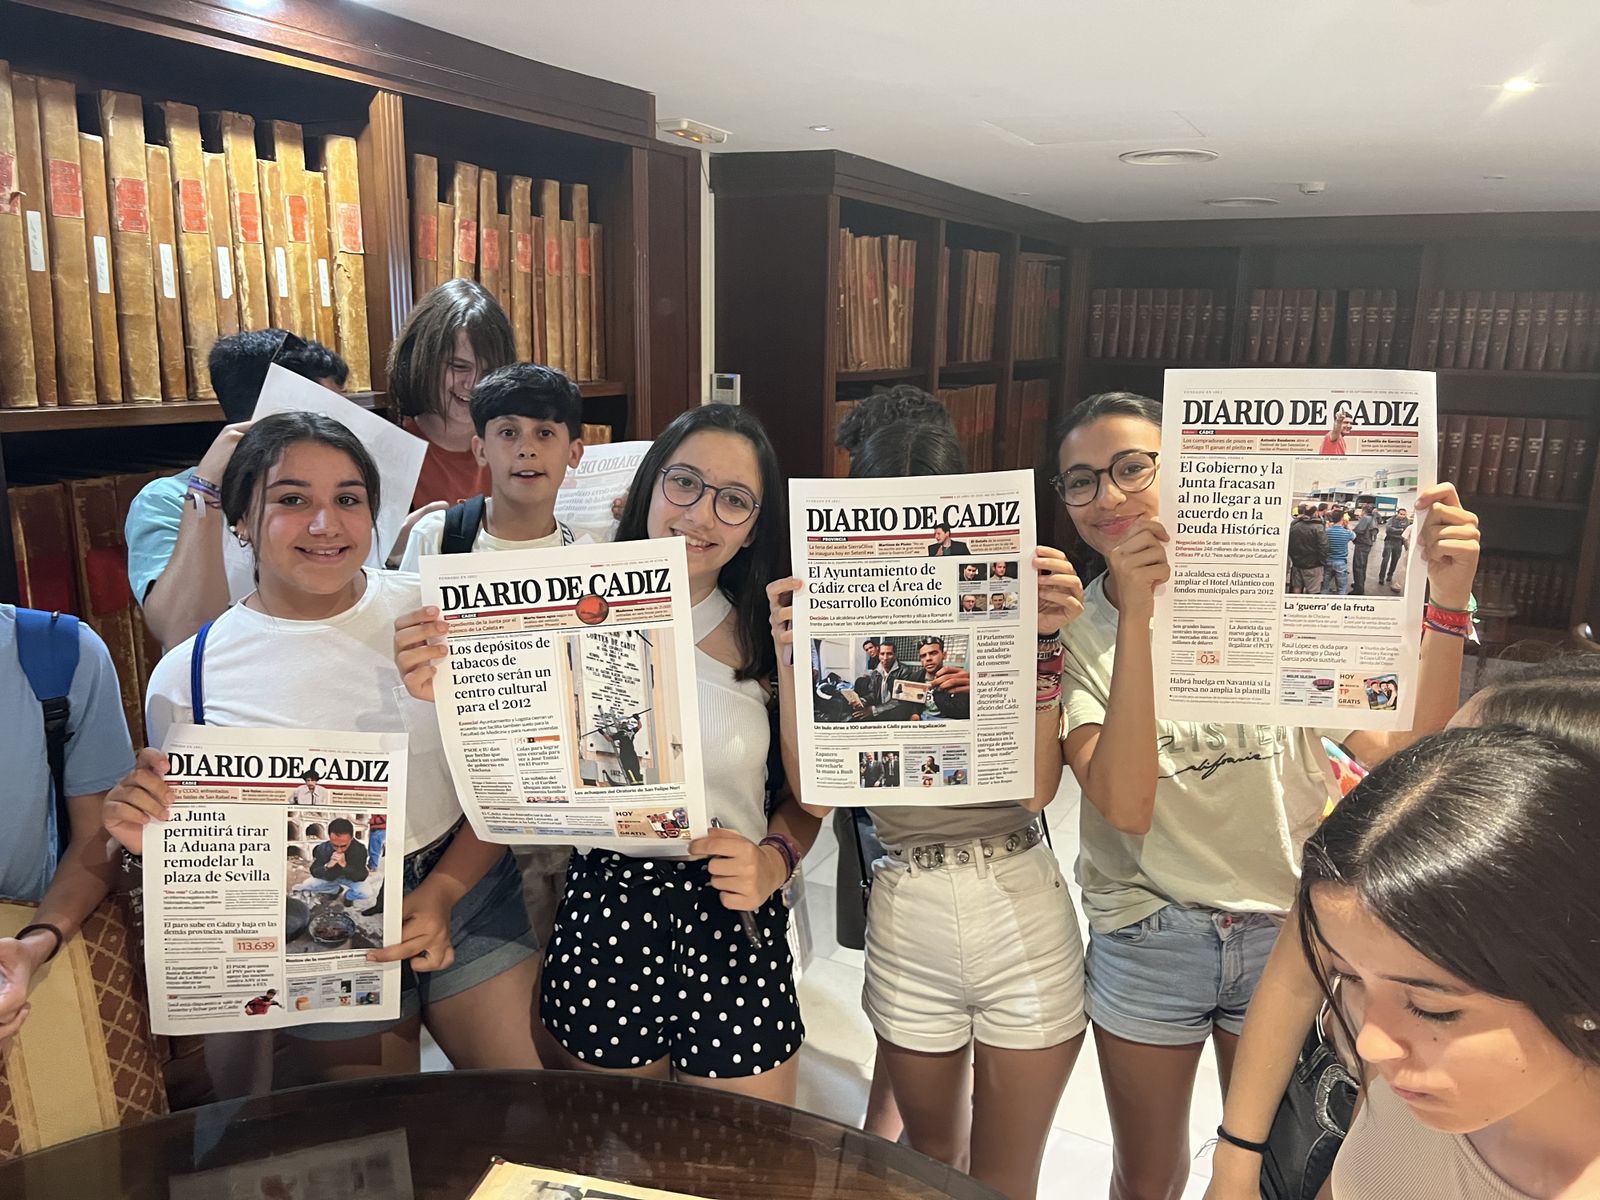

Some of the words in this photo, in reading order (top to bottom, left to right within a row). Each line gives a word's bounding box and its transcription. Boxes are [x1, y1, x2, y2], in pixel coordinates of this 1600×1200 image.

[1182, 400, 1283, 425] DIARIO
[1289, 401, 1326, 426] DE
[1180, 461, 1192, 473] El
[1195, 461, 1257, 474] Gobierno
[1260, 465, 1267, 477] y
[1271, 462, 1283, 474] la
[1179, 476, 1215, 488] Junta
[1219, 477, 1275, 489] fracasan
[1178, 491, 1189, 503] al
[1193, 494, 1209, 503] no
[1212, 492, 1250, 507] llegar
[1253, 496, 1260, 504] a
[1264, 496, 1282, 504] un
[806, 507, 897, 531] DIARIO
[904, 505, 938, 528] DE
[942, 501, 1020, 527] CADIZ
[1177, 506, 1229, 519] acuerdo
[1232, 510, 1247, 519] en
[1251, 507, 1263, 519] la
[1177, 521, 1217, 534] Deuda
[1221, 522, 1280, 535] Histórica
[808, 566, 820, 578] El
[824, 563, 917, 581] Ayuntamiento
[920, 562, 935, 575] de
[1183, 570, 1215, 578] alcaldesa
[1231, 570, 1264, 580] dispuesta
[440, 579, 541, 611] DIARIO
[546, 576, 584, 602] DE
[589, 568, 670, 598] CADIZ
[809, 580, 844, 594] Cádiz
[847, 583, 874, 592] crea
[878, 579, 889, 591] el
[892, 575, 923, 591] Área
[926, 577, 942, 590] de
[1173, 578, 1201, 588] ampliar
[1173, 586, 1196, 594] fondos
[1196, 586, 1239, 596] municipales
[1239, 589, 1256, 597] para
[1256, 587, 1274, 595] 2012
[809, 595, 877, 609] Desarrollo
[880, 593, 951, 607] Económico
[1284, 601, 1294, 610] La
[1295, 601, 1329, 613] 'guerra'
[1330, 602, 1342, 611] de
[1342, 602, 1351, 611] la
[1352, 602, 1375, 611] fruta
[449, 643, 471, 656] Los
[473, 639, 533, 657] depósitos
[535, 638, 550, 650] de
[451, 655, 499, 670] tabacos
[501, 654, 516, 666] de
[452, 670, 494, 684] Loreto
[497, 668, 532, 681] serán
[535, 669, 551, 678] un
[1191, 677, 1215, 687] huelga
[1225, 677, 1256, 686] Navantia
[1264, 678, 1271, 686] la
[454, 685, 495, 699] centro
[497, 681, 547, 696] cultural
[1169, 686, 1199, 695] empresa
[1233, 686, 1241, 694] la
[1241, 686, 1271, 697] plantilla
[456, 703, 485, 716] para
[488, 699, 499, 710] el
[501, 696, 531, 709] 2012
[165, 754, 263, 778] DIARIO
[270, 757, 305, 779] DE
[309, 758, 389, 782] CADIZ
[165, 812, 182, 821] a
[185, 810, 225, 821] Junta
[164, 826, 232, 840] permitirá
[237, 826, 268, 836] tirar
[164, 842, 175, 852] la
[180, 841, 235, 852] Aduana
[239, 844, 270, 854] para
[164, 856, 238, 867] remodelar
[242, 856, 254, 866] la
[164, 871, 200, 885] plaza
[205, 871, 221, 881] de
[225, 870, 270, 881] Sevilla
[236, 941, 275, 950] 113.639
